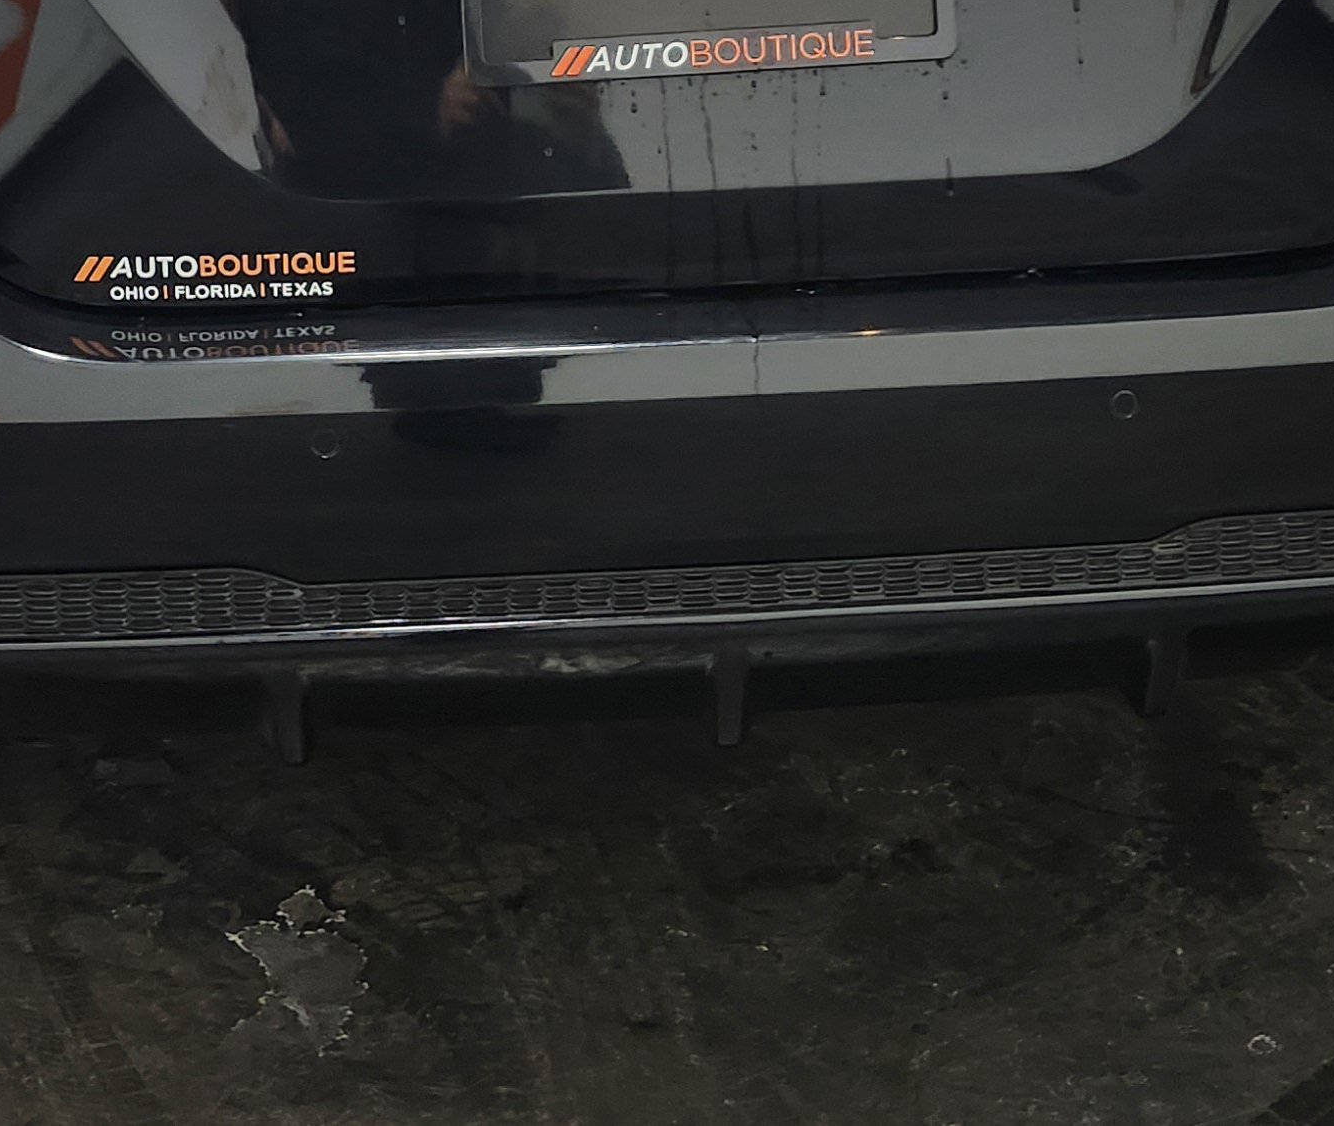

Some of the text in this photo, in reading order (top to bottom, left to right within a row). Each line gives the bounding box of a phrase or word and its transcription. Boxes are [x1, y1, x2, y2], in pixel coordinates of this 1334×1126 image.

[586, 29, 875, 73] AUTOBOUTIQUE
[109, 251, 356, 279] AUTOBOUTIQUE
[109, 281, 334, 301] OHIO FLORIDA TEXAS
